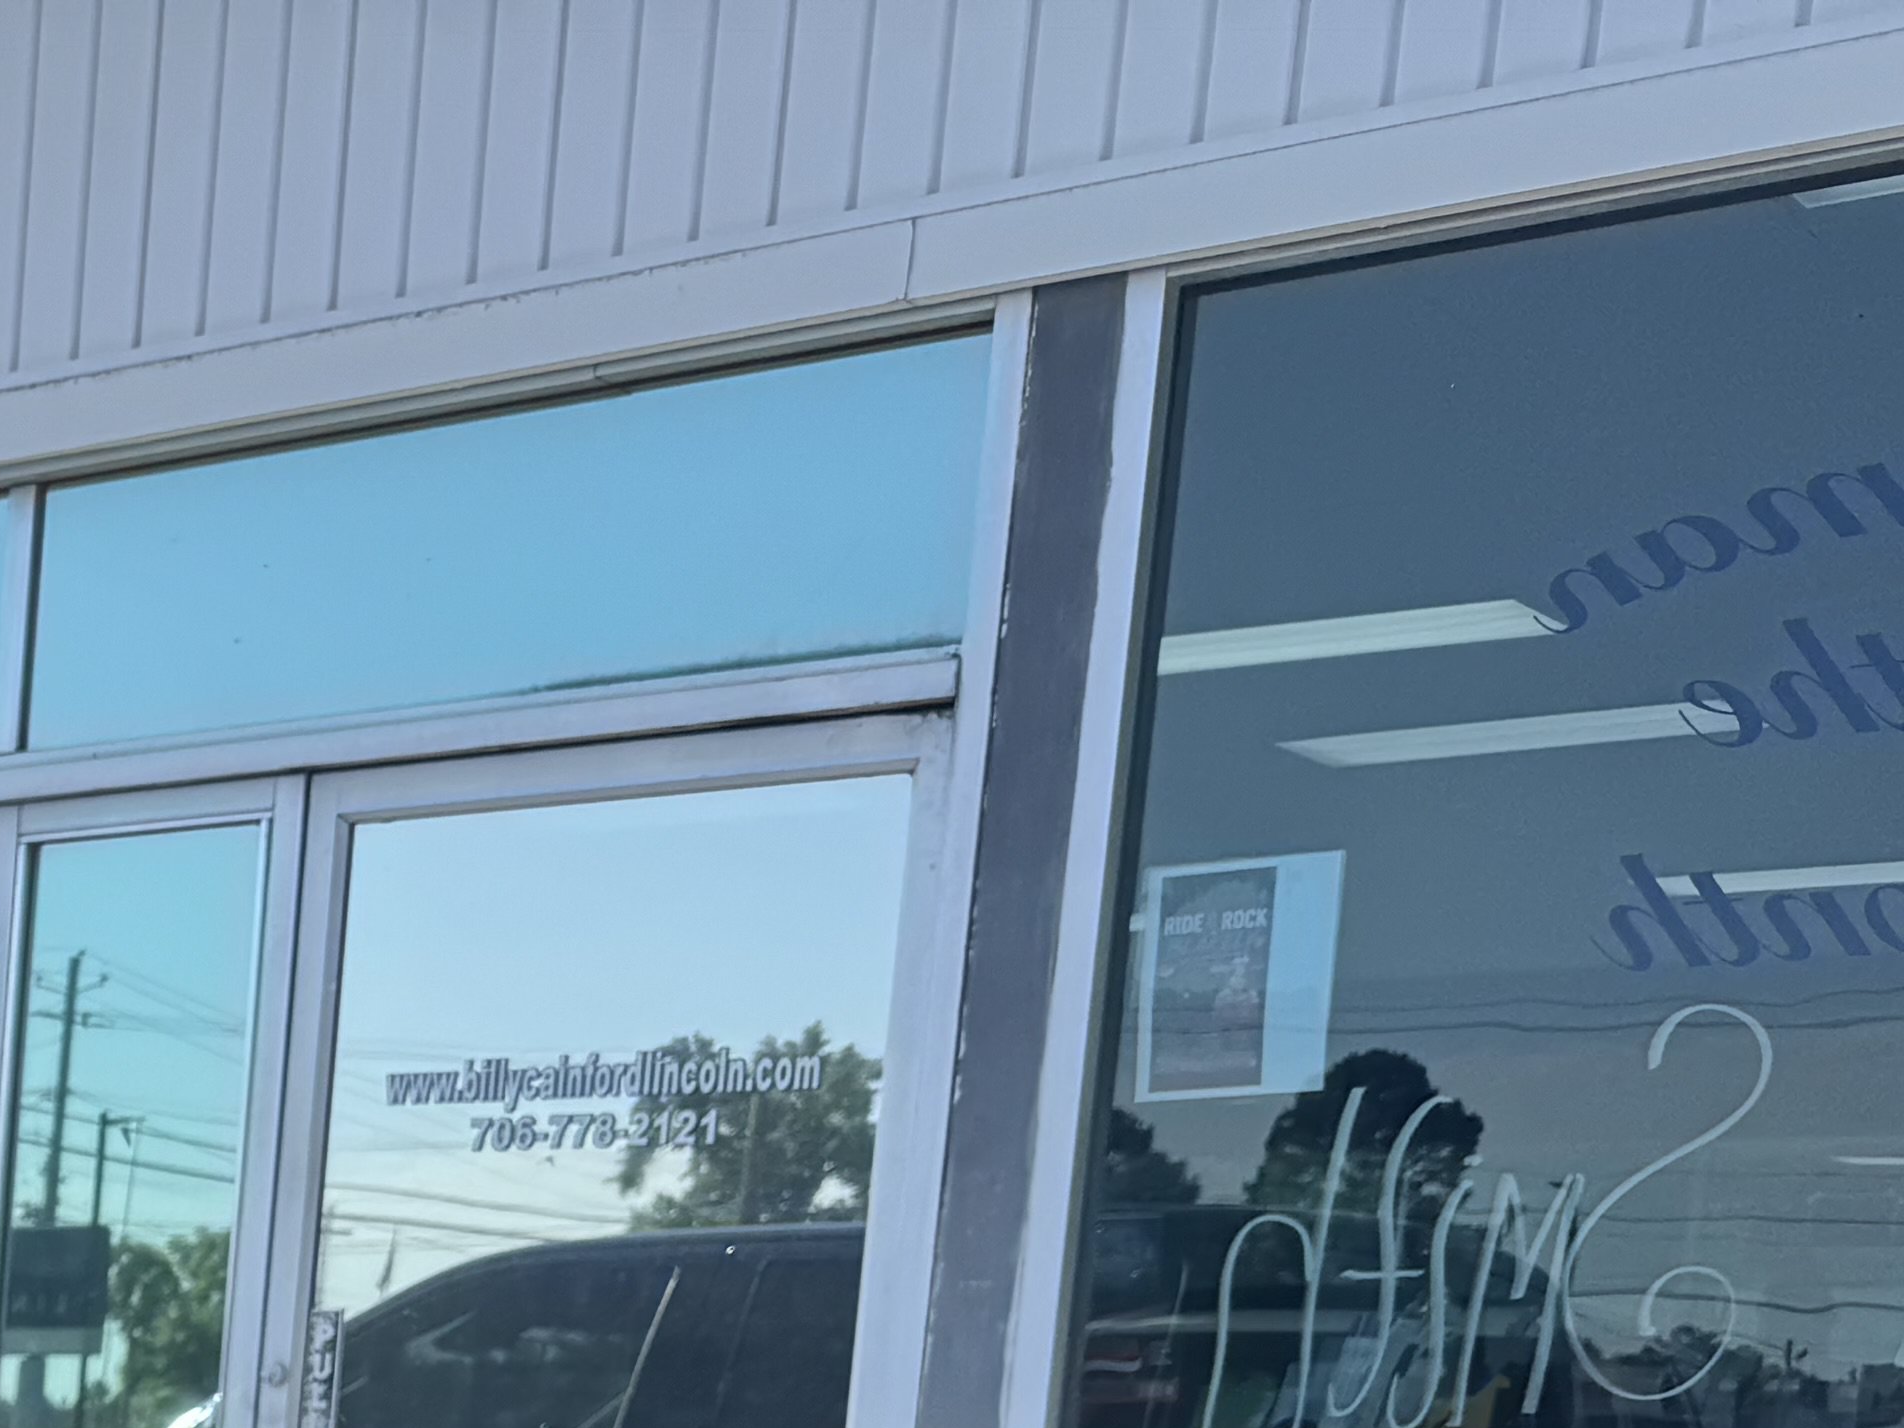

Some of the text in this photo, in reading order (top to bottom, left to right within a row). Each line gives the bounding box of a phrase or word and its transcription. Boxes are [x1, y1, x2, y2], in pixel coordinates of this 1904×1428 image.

[1163, 912, 1205, 937] RIDE
[1220, 907, 1269, 931] ROCK
[385, 1046, 822, 1112] www.billycainfordlincoln.com
[469, 1107, 720, 1153] 706-778-2121
